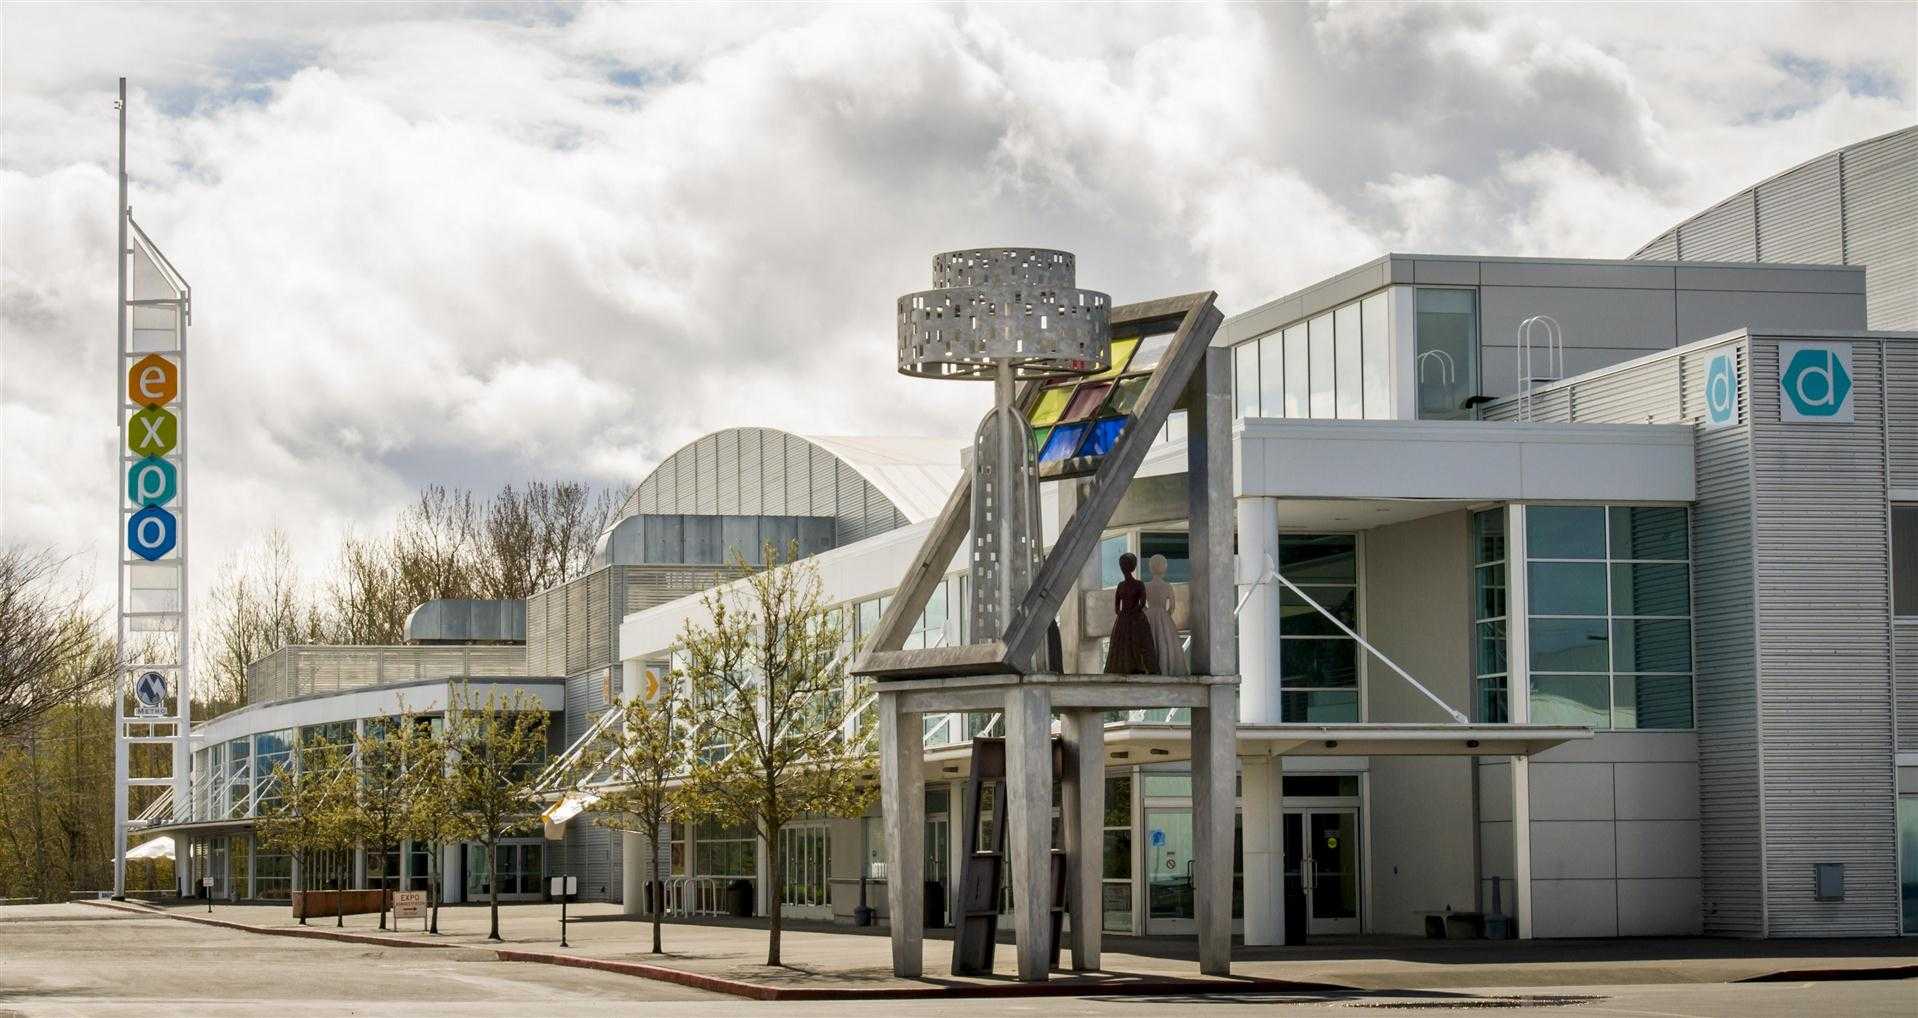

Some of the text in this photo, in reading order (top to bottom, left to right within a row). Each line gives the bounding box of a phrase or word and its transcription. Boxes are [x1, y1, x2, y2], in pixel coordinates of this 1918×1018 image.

[1711, 355, 1729, 412] d
[1796, 349, 1834, 406] d
[137, 366, 166, 548] expo
